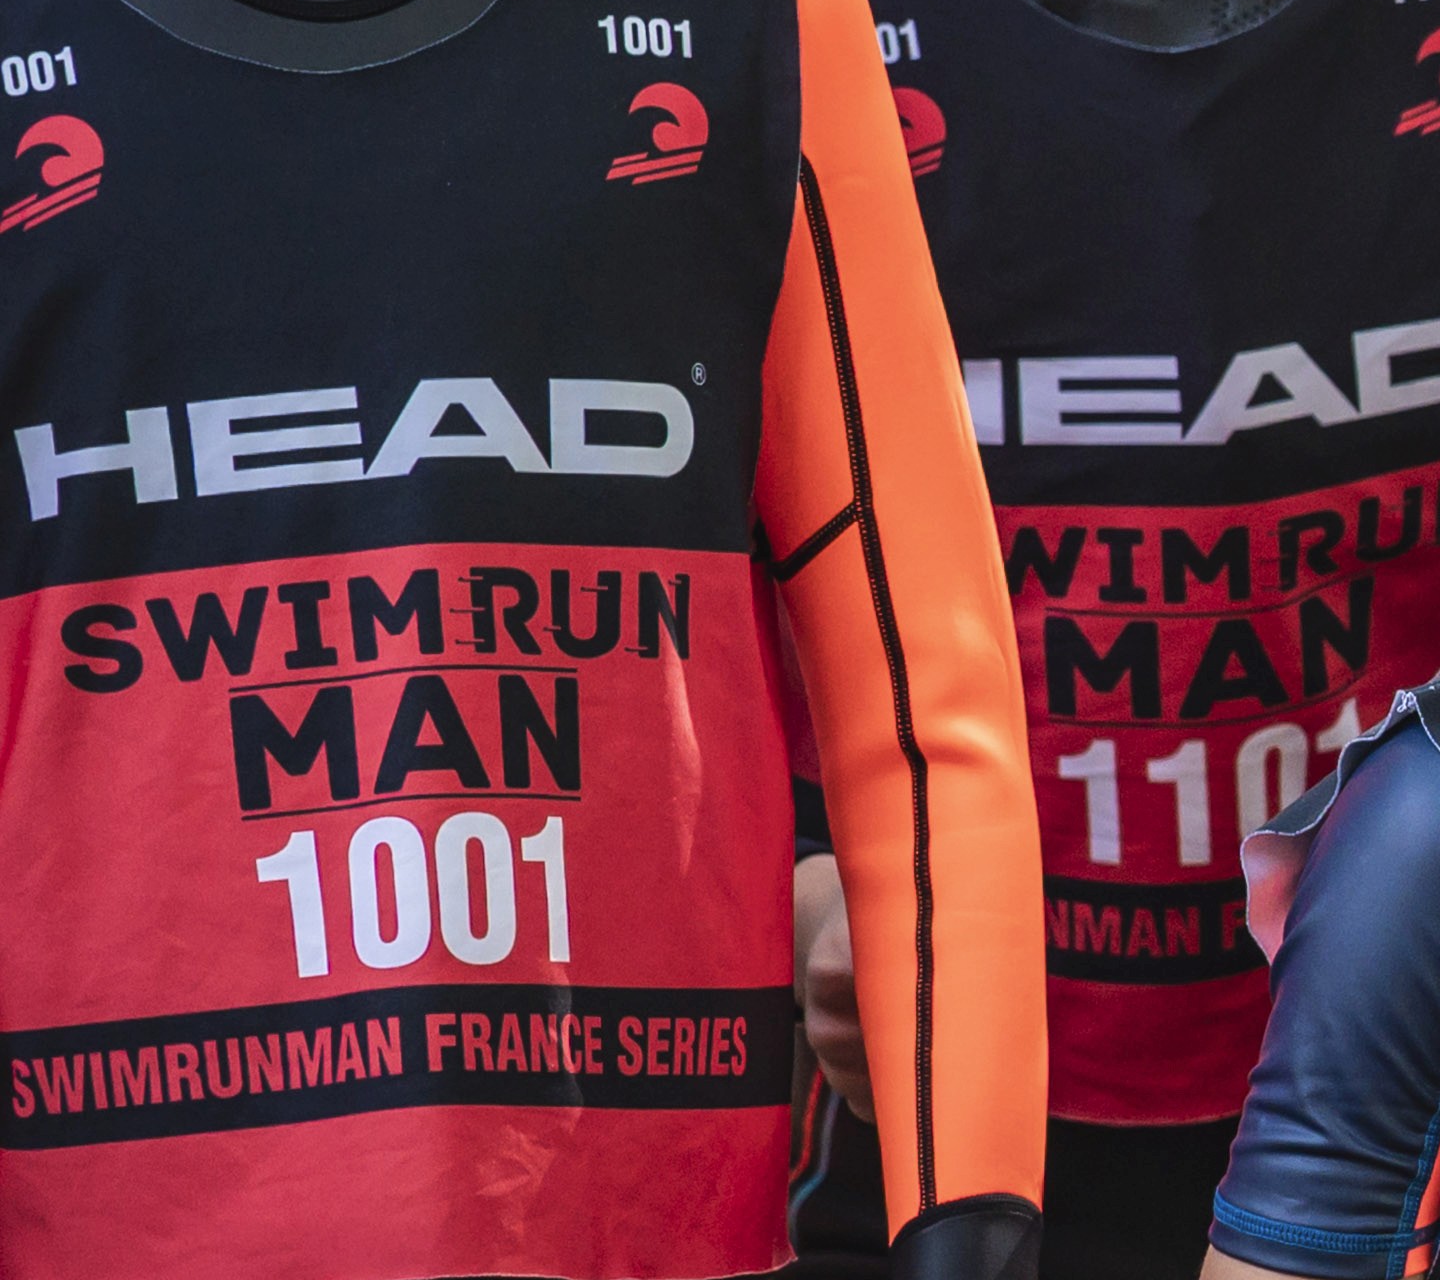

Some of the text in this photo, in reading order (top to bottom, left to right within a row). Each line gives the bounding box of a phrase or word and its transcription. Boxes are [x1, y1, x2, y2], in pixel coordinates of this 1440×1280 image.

[2, 46, 78, 96] 001
[598, 15, 693, 59] 1001
[875, 19, 921, 65] 01
[14, 376, 695, 522] HEAD
[61, 565, 692, 693] SWIMRUN
[1043, 577, 1375, 720] MAN
[228, 674, 582, 812] MAN
[256, 811, 572, 979] 1001
[12, 1012, 749, 1119] SWIMRUNMAN FRANCE SERIES
